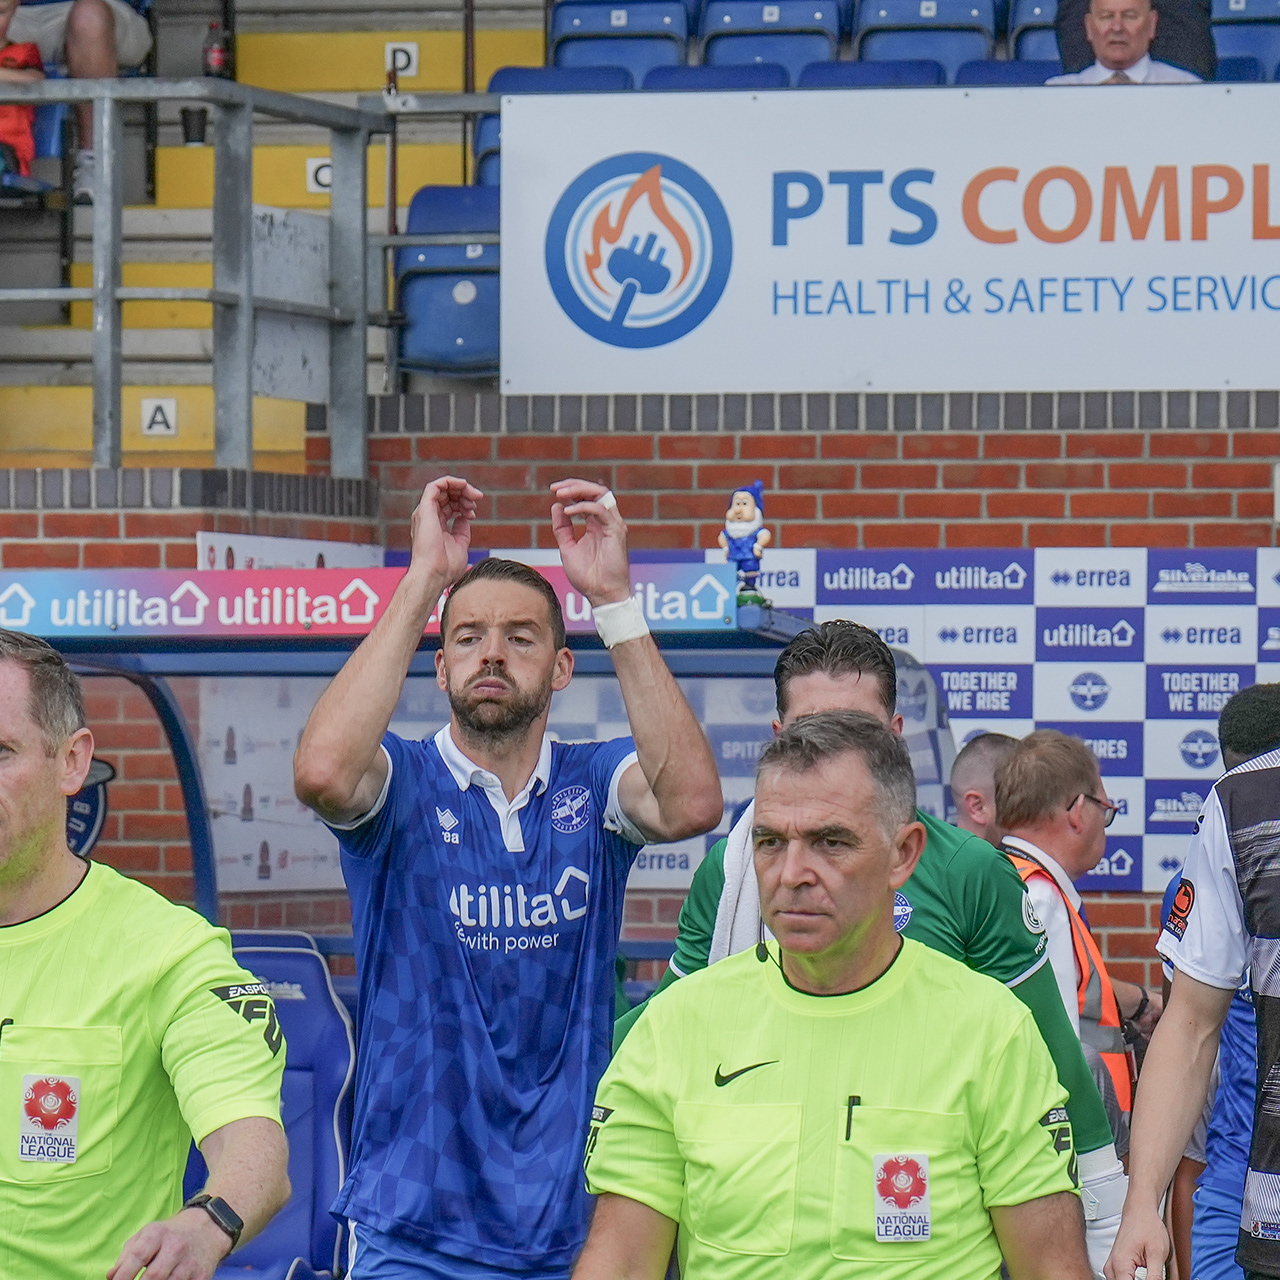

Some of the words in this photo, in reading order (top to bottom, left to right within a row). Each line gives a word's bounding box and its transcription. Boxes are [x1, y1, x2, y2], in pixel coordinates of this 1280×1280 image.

[392, 49, 410, 72] D
[771, 169, 938, 247] PTS
[772, 278, 931, 316] HEALTH
[944, 278, 973, 315] &
[986, 276, 1134, 314] SAFETY
[147, 405, 171, 430] A
[757, 570, 799, 587] rrea
[823, 566, 891, 590] utilita
[935, 565, 1004, 589] utilita
[1076, 569, 1131, 587] errea
[50, 588, 169, 627] utilita
[218, 586, 330, 626] utilita
[877, 626, 909, 644] rea
[963, 626, 1017, 644] errea
[1043, 623, 1112, 647] utilita
[1186, 626, 1241, 644] errea
[941, 671, 1018, 691] TOGETHER
[1161, 672, 1239, 692] TOGETHER
[948, 692, 972, 711] WE
[975, 692, 1011, 711] RISE
[1168, 692, 1193, 712] WE
[637, 852, 689, 870] errea
[505, 932, 559, 954] power
[21, 1135, 75, 1146] NATIONAL
[20, 1144, 74, 1158] LEAGUE
[876, 1215, 929, 1225] NATIONAL
[877, 1224, 929, 1236] LEAGUE
